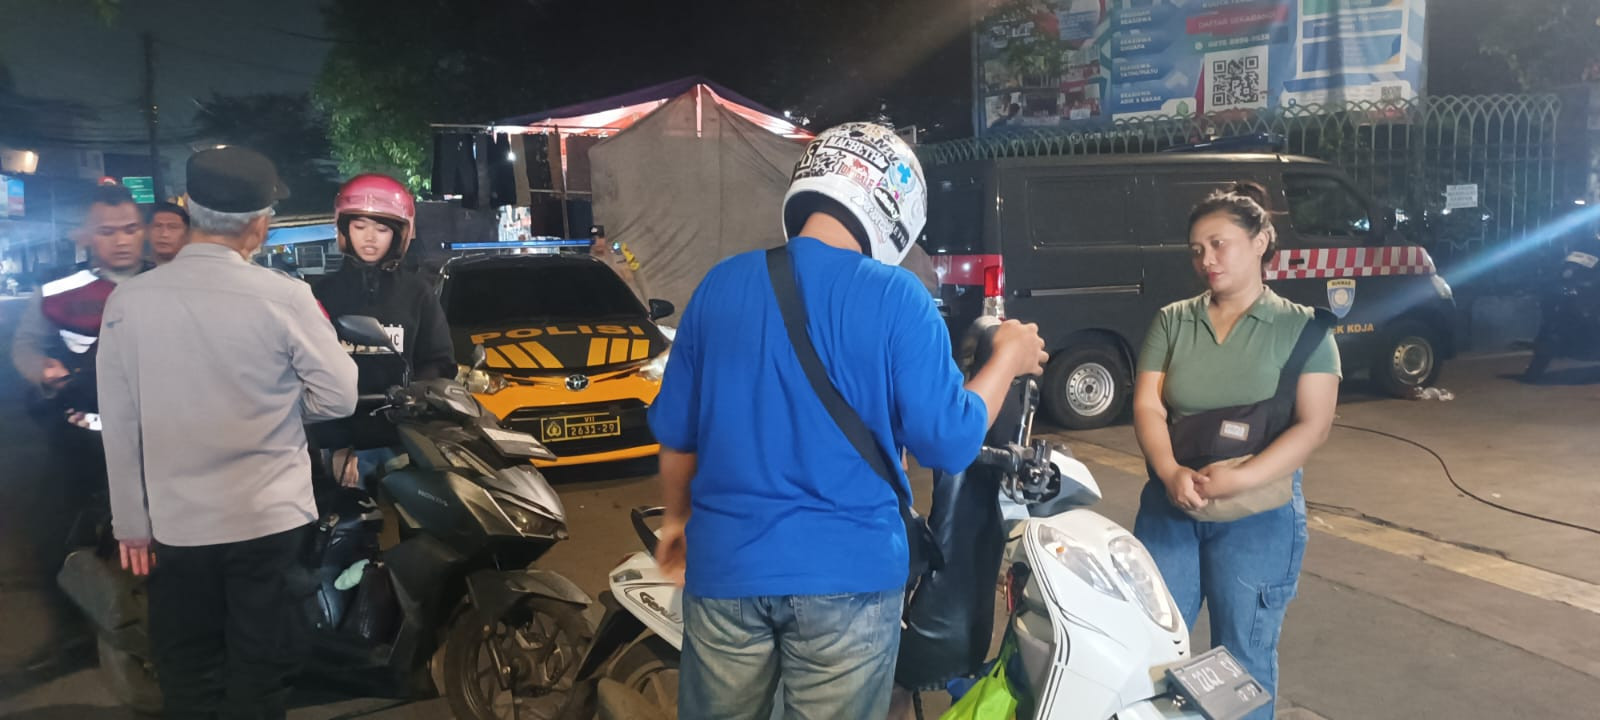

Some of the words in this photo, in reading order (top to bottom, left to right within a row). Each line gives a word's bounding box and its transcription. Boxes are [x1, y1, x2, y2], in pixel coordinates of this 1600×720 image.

[827, 136, 882, 163] MACBETH
[470, 325, 645, 345] POLISI
[1347, 323, 1374, 333] KOJA
